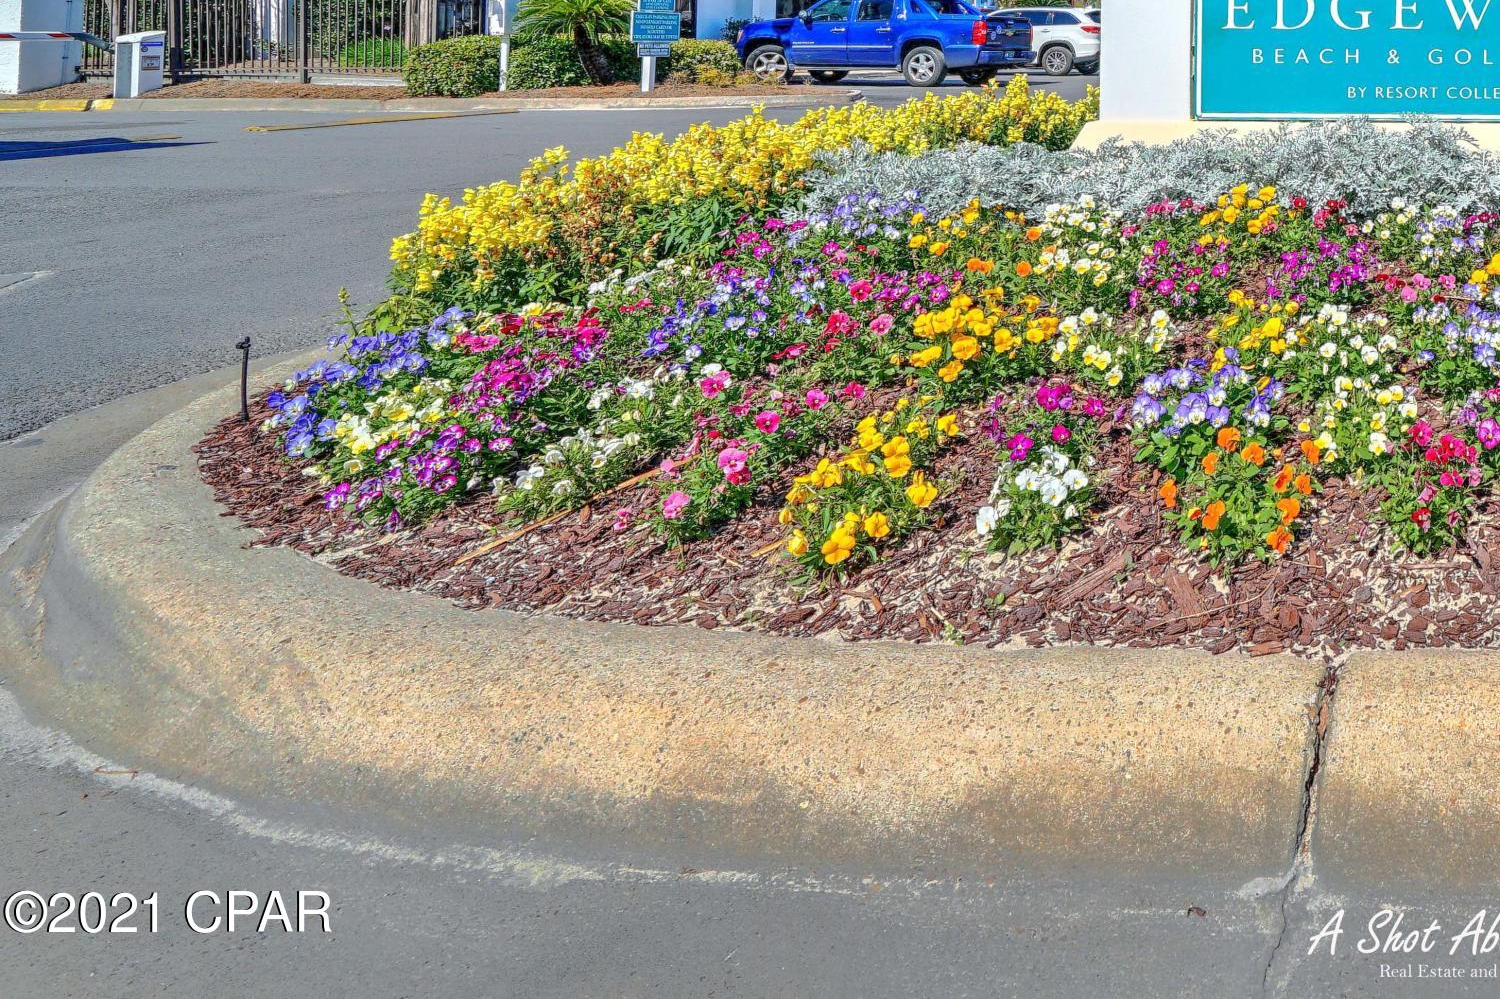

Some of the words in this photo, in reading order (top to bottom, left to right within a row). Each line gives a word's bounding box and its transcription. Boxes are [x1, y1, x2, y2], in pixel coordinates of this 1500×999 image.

[1252, 48, 1360, 65] BEACH
[1387, 49, 1400, 65] &
[1347, 86, 1367, 99] BY
[1375, 86, 1438, 100] RESORT
